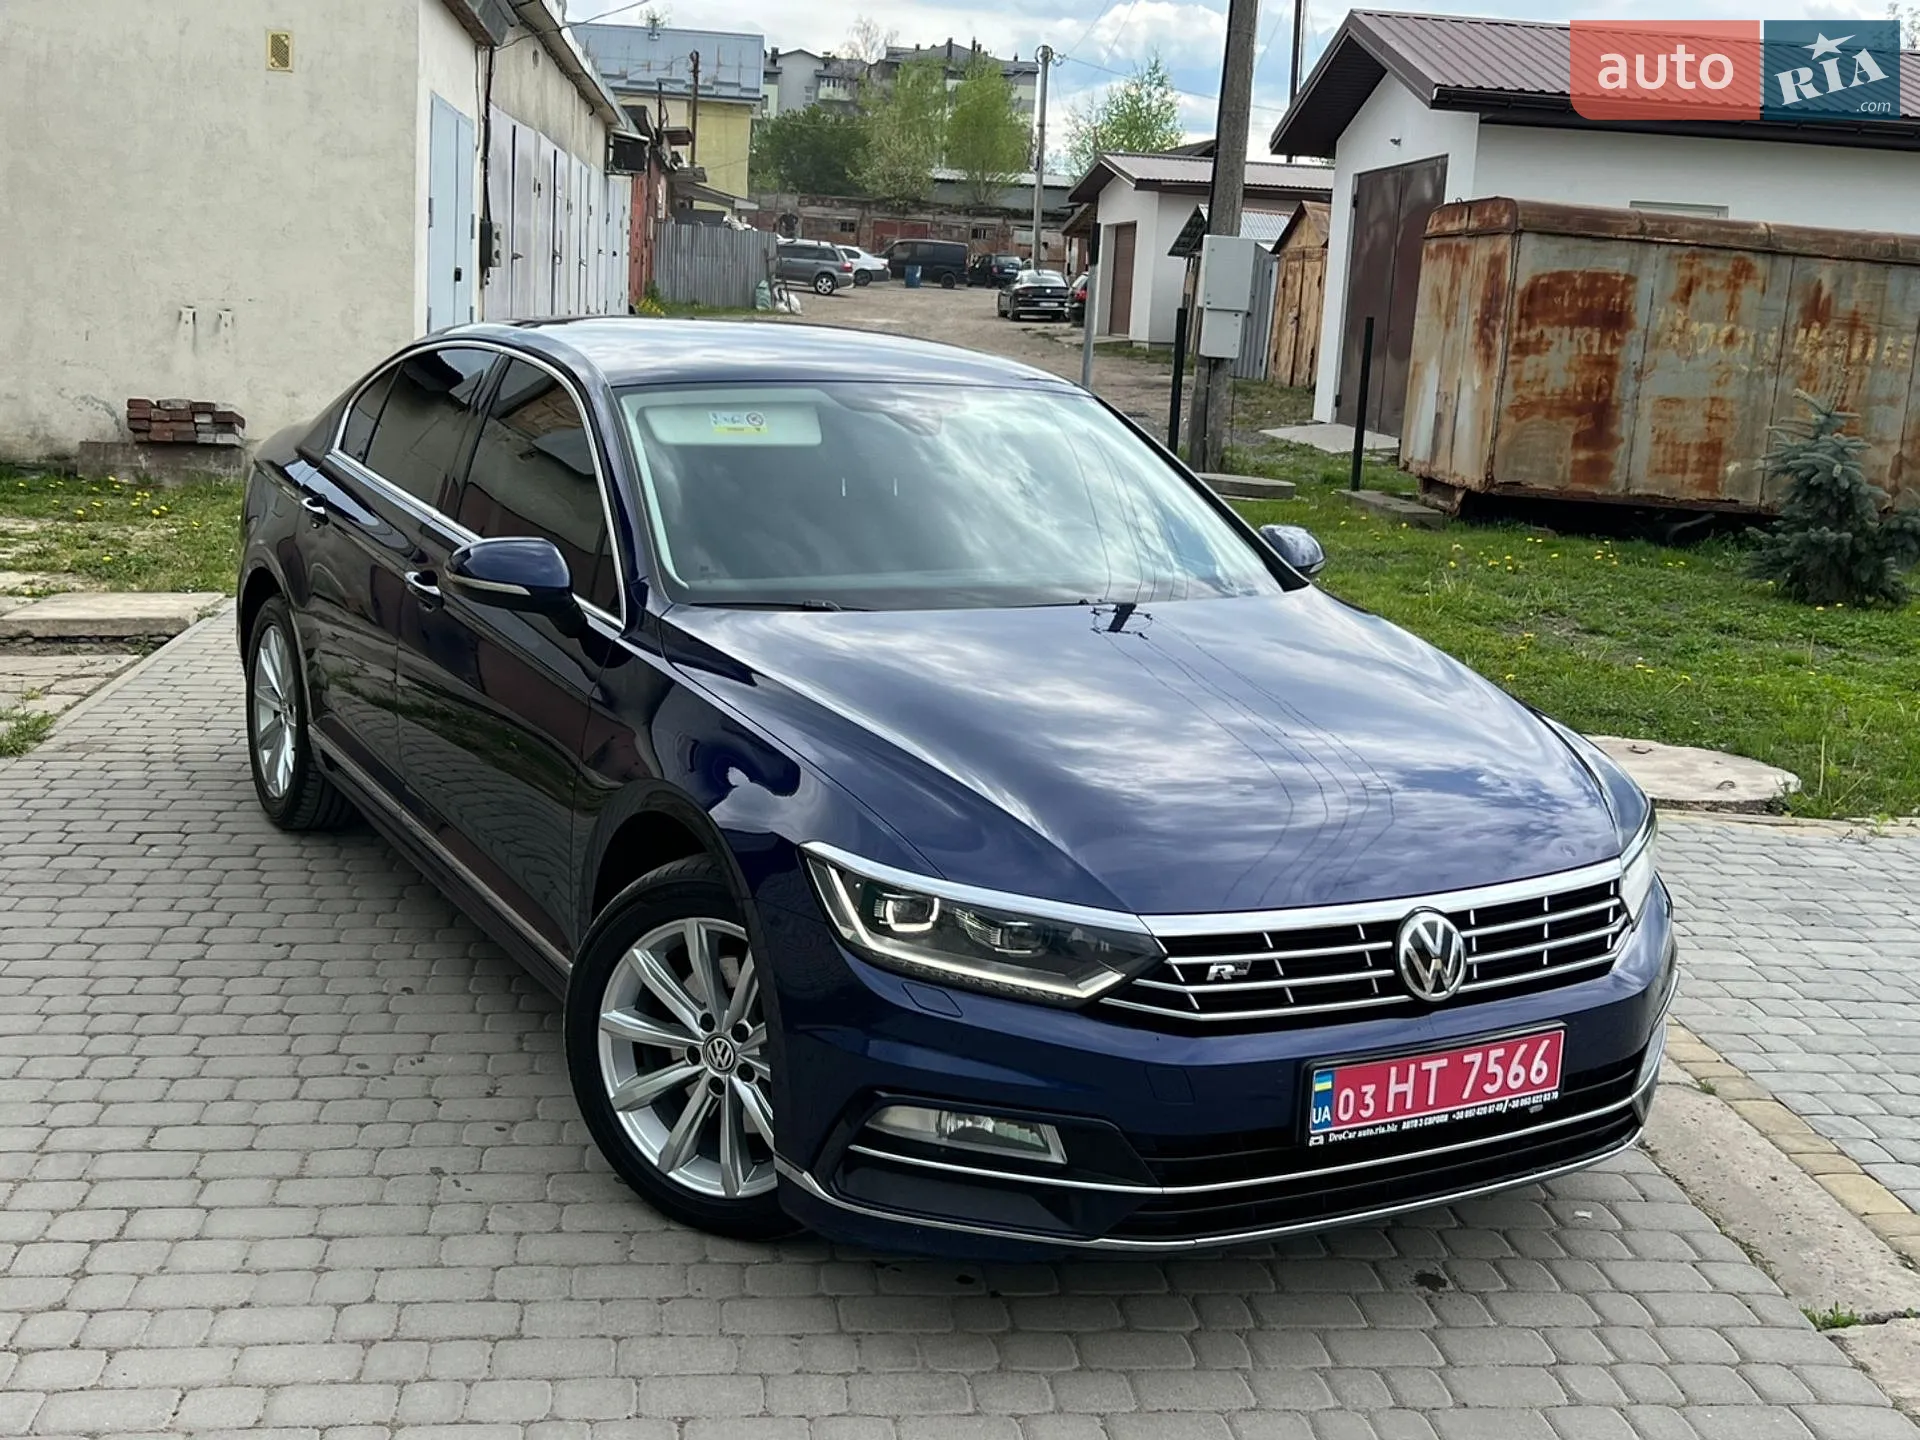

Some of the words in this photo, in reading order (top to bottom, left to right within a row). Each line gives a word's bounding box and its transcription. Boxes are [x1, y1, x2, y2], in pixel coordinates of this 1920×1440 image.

[1337, 1084, 1376, 1121] 03
[1387, 1058, 1448, 1113] HT
[1461, 1039, 1550, 1100] 7566
[1312, 1106, 1331, 1124] UA
